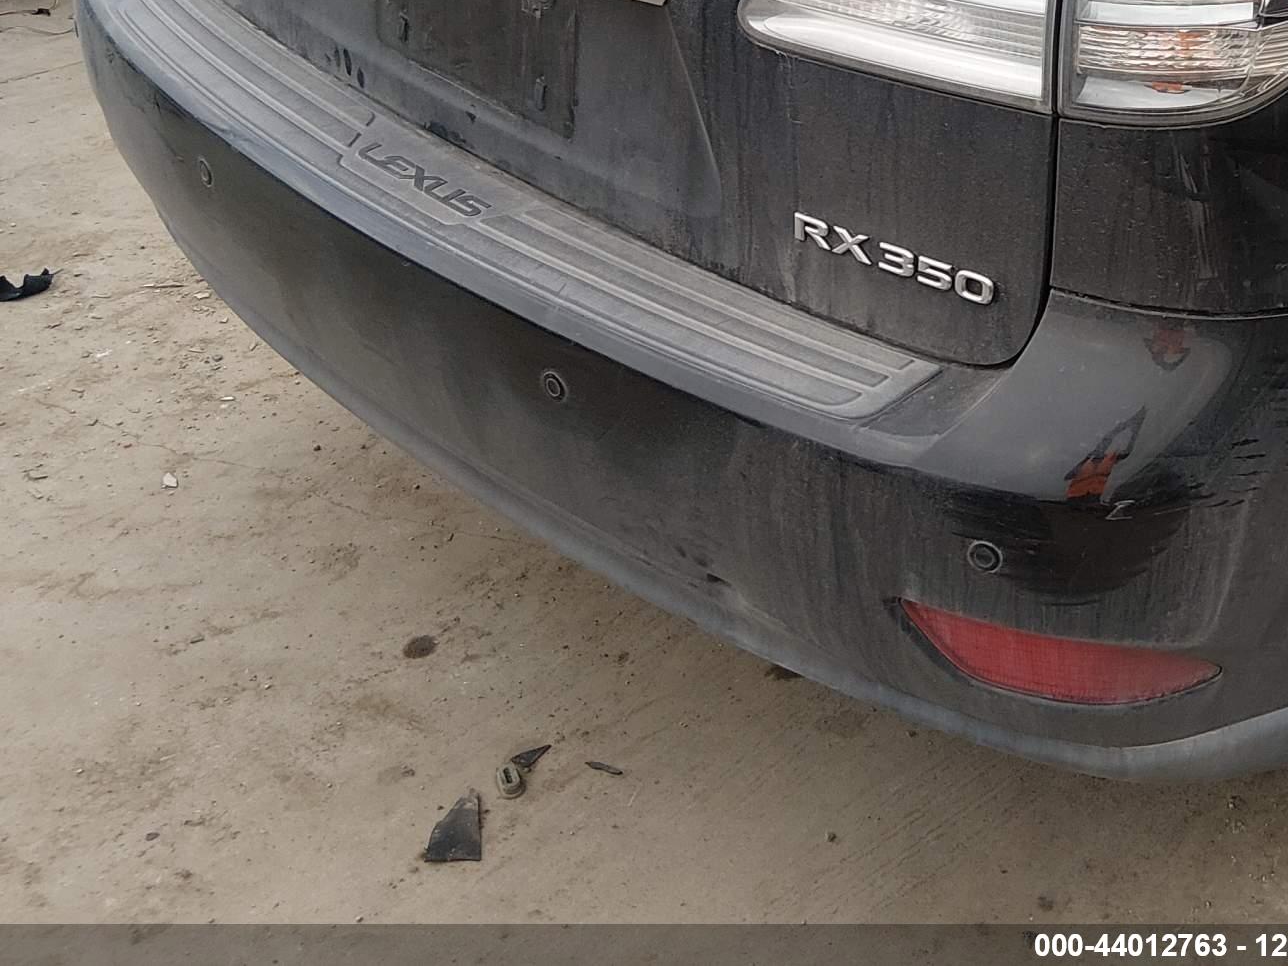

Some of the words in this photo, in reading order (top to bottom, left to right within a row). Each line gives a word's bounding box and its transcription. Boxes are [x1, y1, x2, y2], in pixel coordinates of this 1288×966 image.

[358, 142, 492, 217] LEXUS
[794, 212, 872, 266] RX
[878, 241, 995, 306] 350
